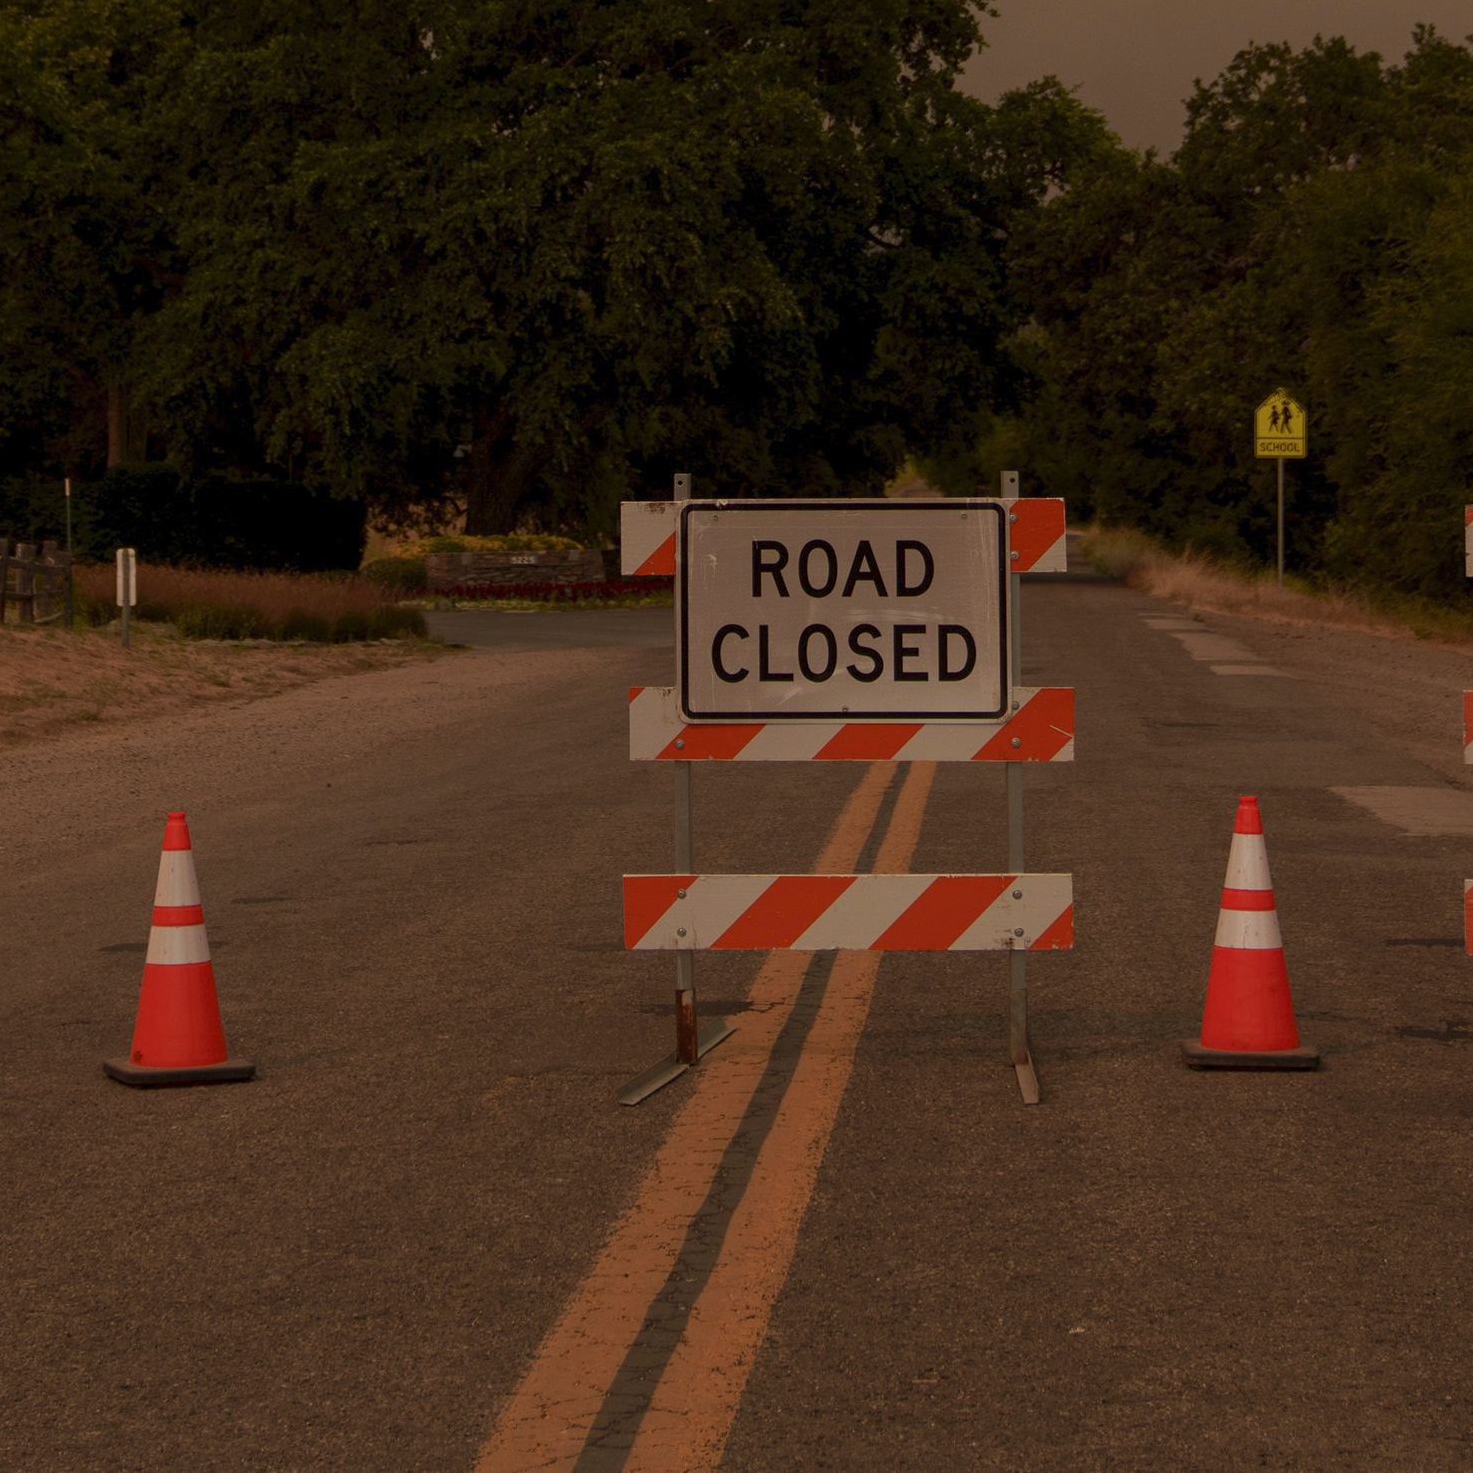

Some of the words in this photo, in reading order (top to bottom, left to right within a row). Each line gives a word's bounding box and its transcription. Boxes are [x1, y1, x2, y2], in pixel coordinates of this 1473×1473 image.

[1259, 442, 1300, 452] SCHOOL
[752, 539, 935, 598] ROAD
[711, 623, 977, 683] CLOSED
